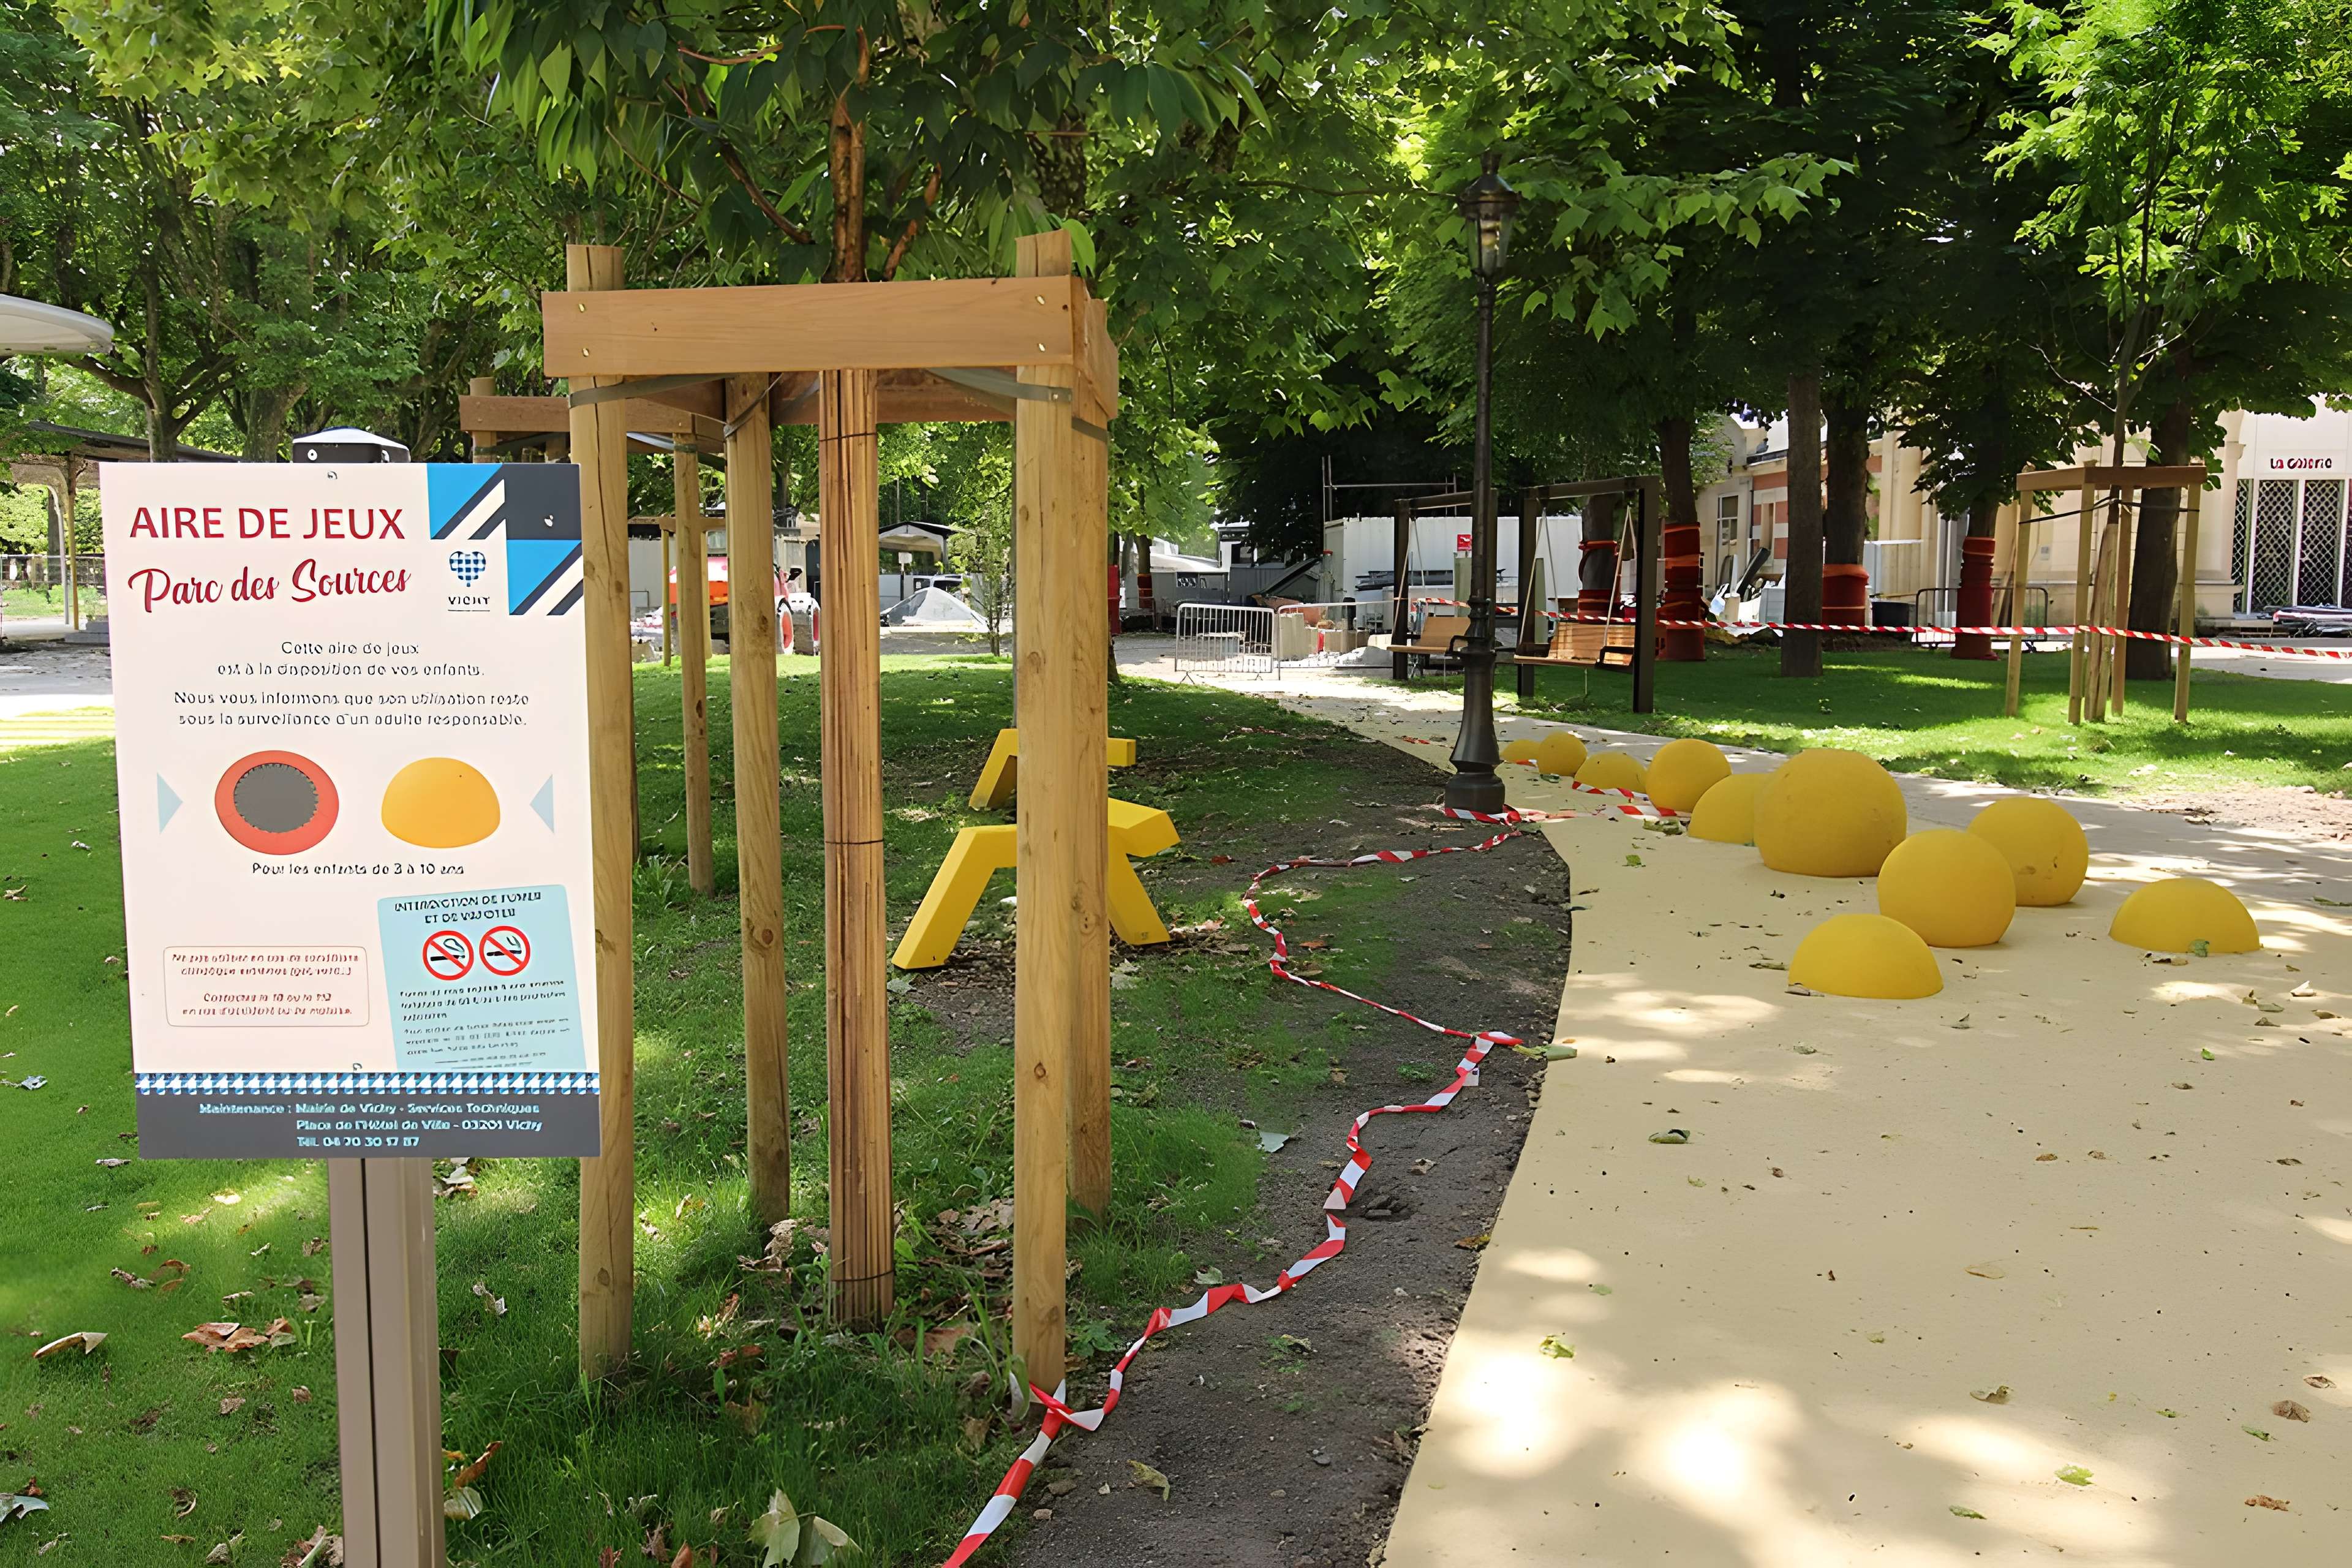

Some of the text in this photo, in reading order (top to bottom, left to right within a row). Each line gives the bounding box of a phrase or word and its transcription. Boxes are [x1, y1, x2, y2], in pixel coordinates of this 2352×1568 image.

[129, 507, 406, 540] AIRE DE JEUX
[127, 557, 412, 613] Parc des Sources
[281, 641, 323, 655] Cette
[328, 641, 358, 655] aire
[363, 641, 382, 655] de
[367, 663, 386, 676] de
[174, 692, 215, 705] Nous
[219, 694, 257, 704] vous
[344, 693, 373, 706] que
[220, 713, 233, 725] la
[289, 863, 309, 875] les
[372, 863, 389, 875] de
[394, 863, 402, 875] 3
[420, 863, 435, 874] 10
